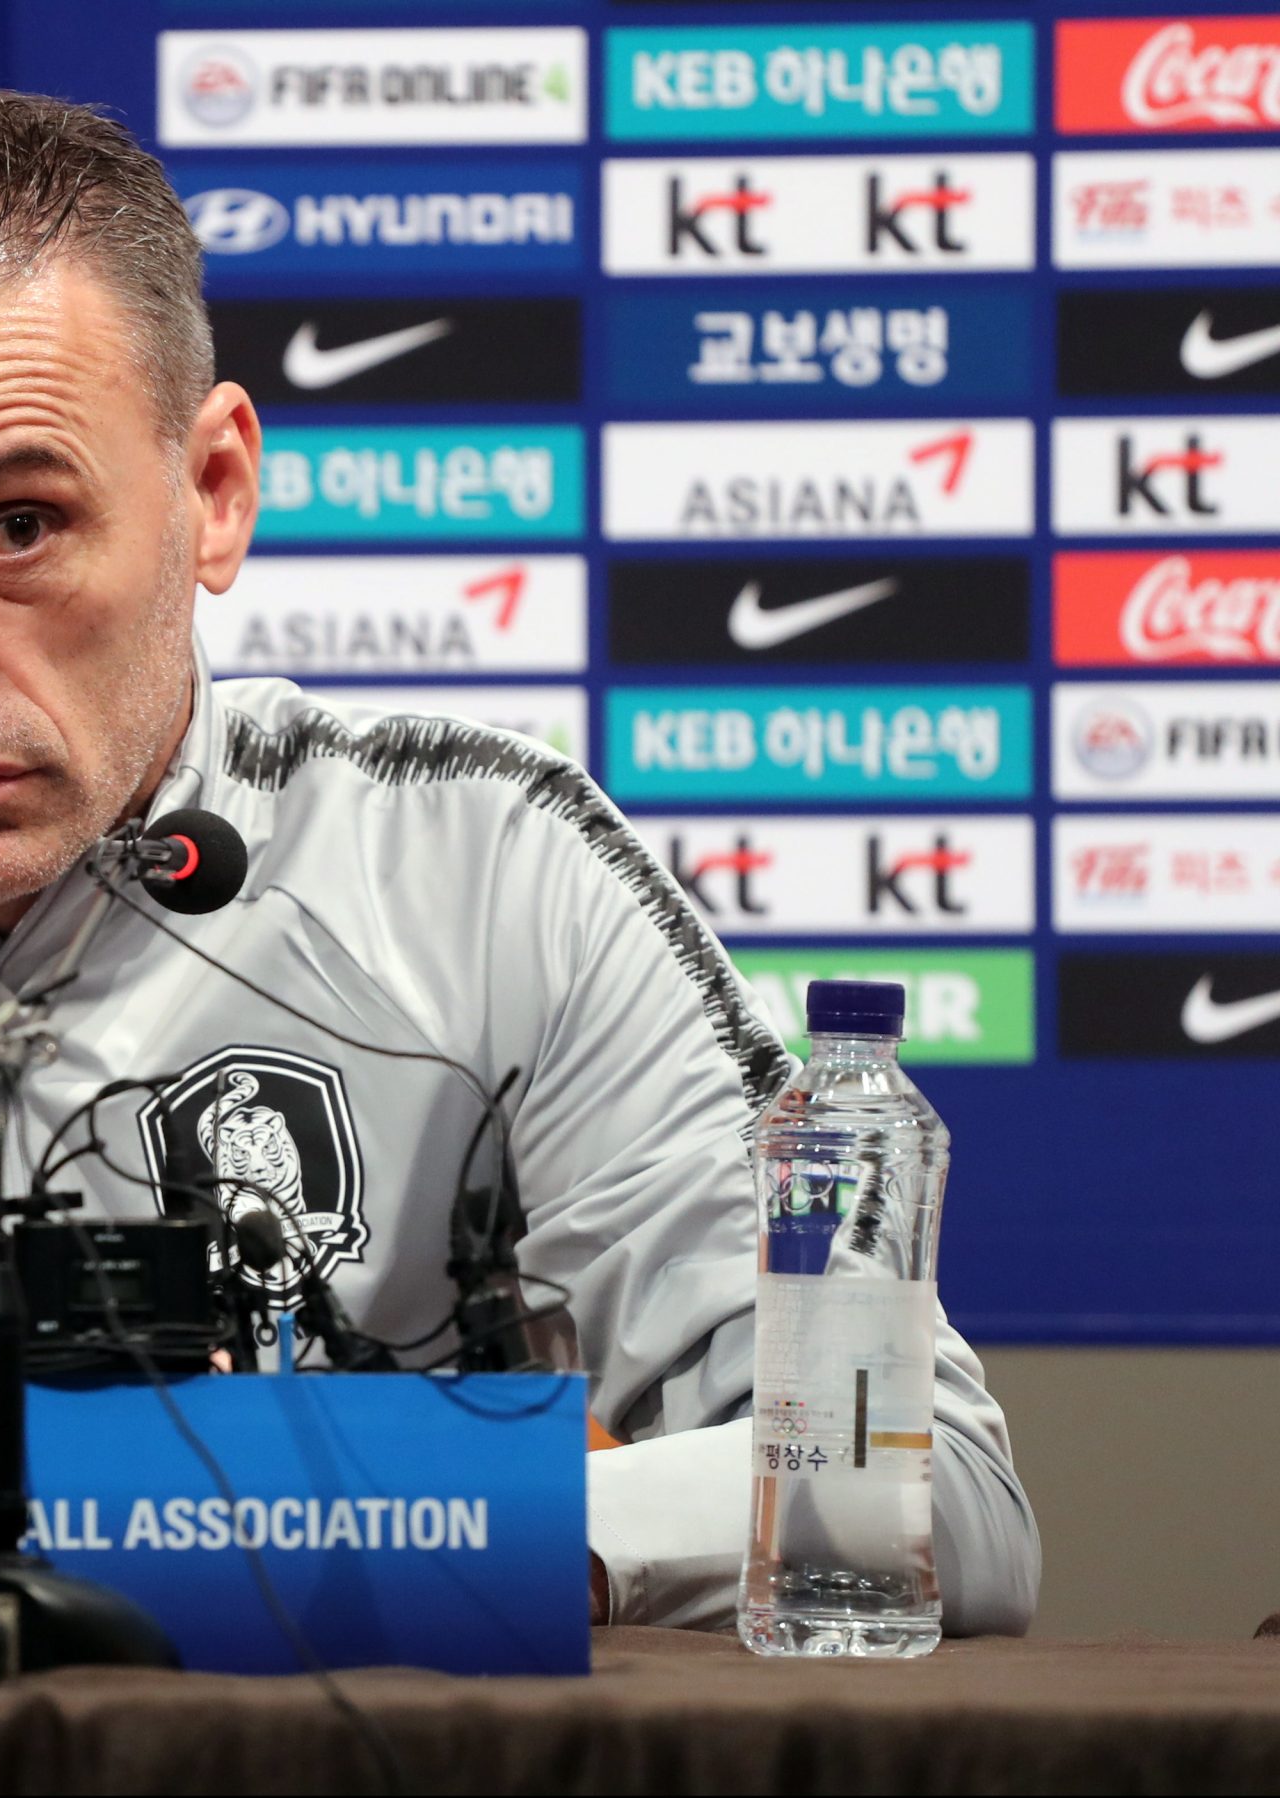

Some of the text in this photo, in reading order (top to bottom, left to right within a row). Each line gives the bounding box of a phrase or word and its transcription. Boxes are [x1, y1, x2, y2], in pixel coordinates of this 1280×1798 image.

[270, 65, 372, 107] FIFA
[379, 64, 533, 107] ONLINE
[632, 43, 1002, 116] KEB 하나은행
[295, 193, 573, 245] HYUNDAI
[668, 172, 970, 257] kt kt
[689, 307, 949, 387] 교보생명
[319, 446, 554, 519] 하나은행
[681, 479, 921, 525] ASIANA
[1117, 433, 1222, 518] kt
[238, 613, 476, 659] ASIANA
[632, 706, 1001, 779] KEB 하나은행
[1166, 719, 1269, 760] FIFA
[670, 832, 970, 915] kt kt
[766, 1443, 828, 1472] 평창수
[123, 1497, 488, 1551] ASSOCIATION
